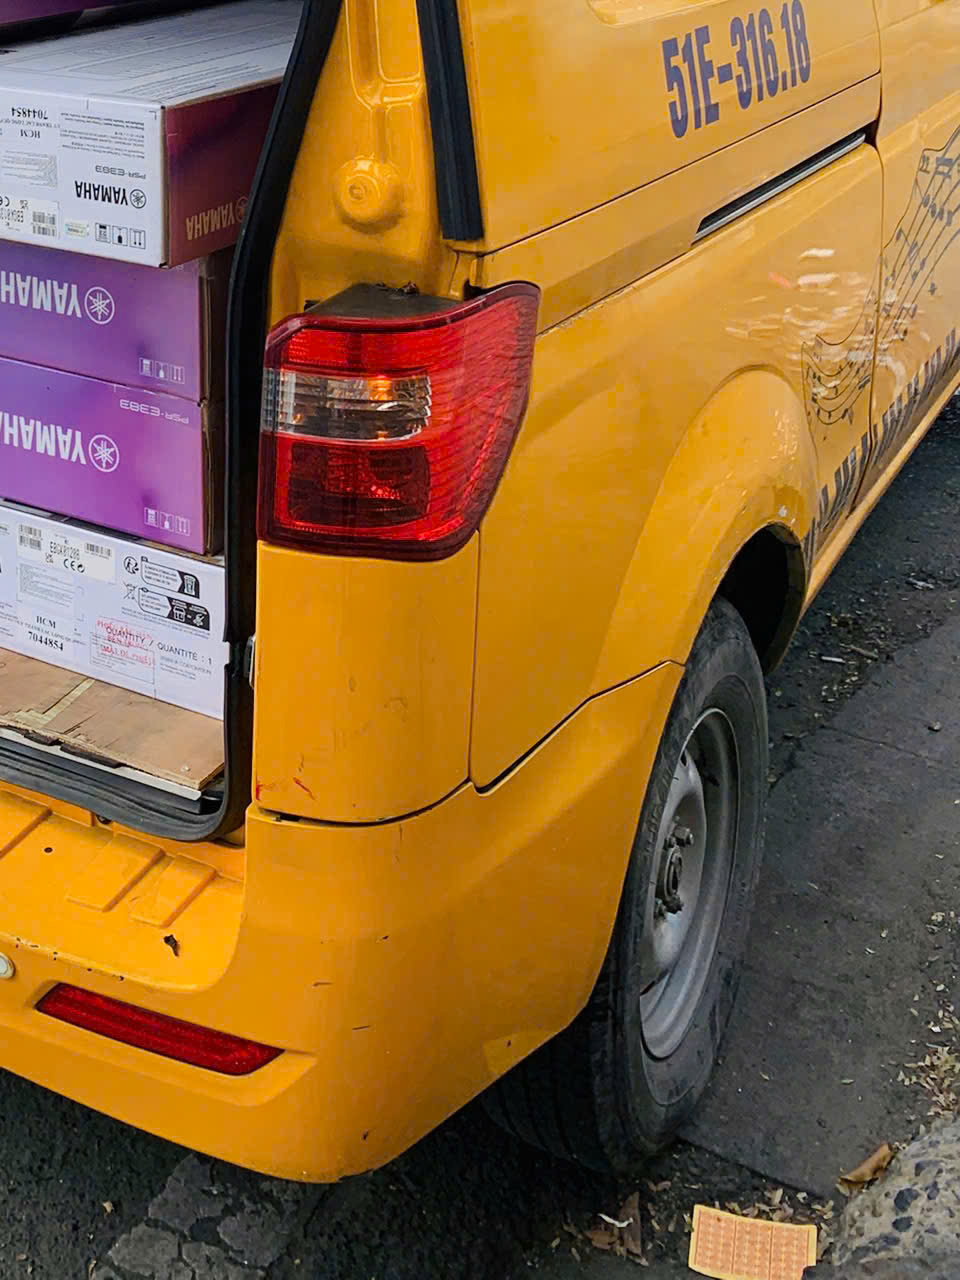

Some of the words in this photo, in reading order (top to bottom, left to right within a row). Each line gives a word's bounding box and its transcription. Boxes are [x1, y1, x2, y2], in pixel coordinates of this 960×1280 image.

[662, 0, 811, 138] 51E-316.18
[11, 107, 48, 120] 7044854
[20, 128, 41, 139] HCM
[74, 180, 129, 206] YAMAHA
[185, 202, 235, 241] YAMAHA
[36, 615, 57, 629] HCM
[28, 631, 64, 651] 7044854
[105, 626, 146, 644] QUANTITY
